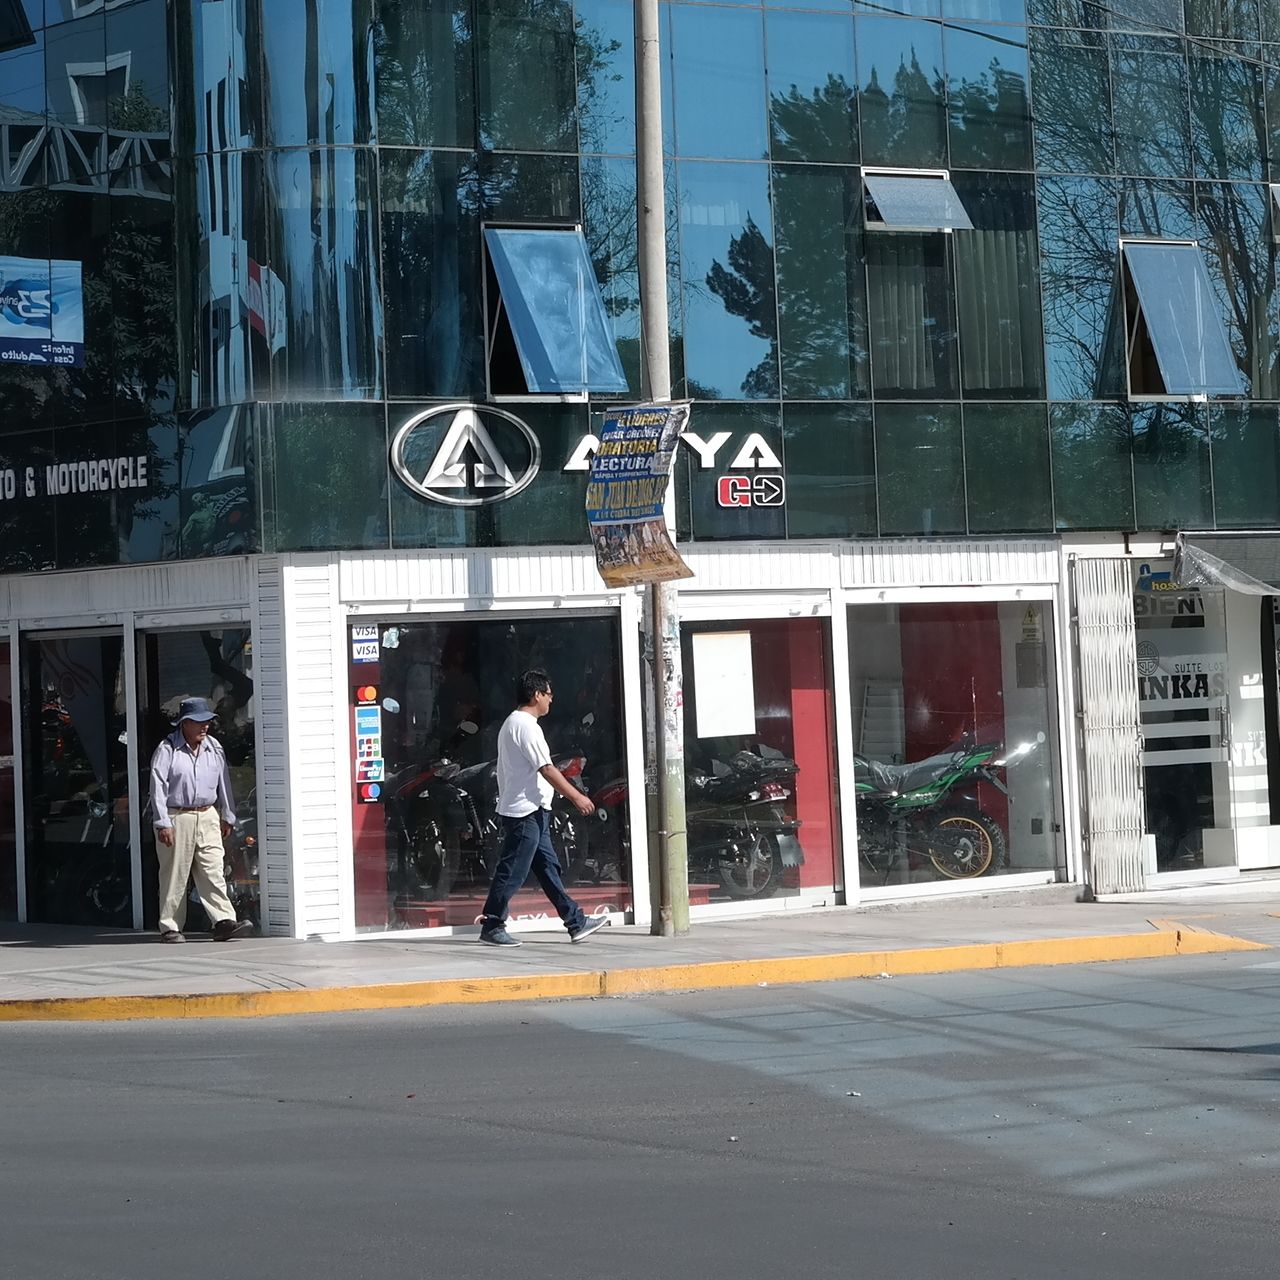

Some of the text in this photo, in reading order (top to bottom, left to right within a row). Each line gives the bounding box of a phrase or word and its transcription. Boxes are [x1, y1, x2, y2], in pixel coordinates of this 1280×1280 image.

[564, 432, 783, 471] AYA
[596, 439, 658, 457] ORATORIA
[592, 455, 656, 472] LECTURA
[25, 465, 37, 498] &
[45, 455, 149, 497] MOTORCYCLE
[355, 627, 377, 636] VISA
[356, 645, 378, 655] VISA
[1174, 662, 1202, 674] SUITE
[1137, 673, 1226, 701] INKAS
